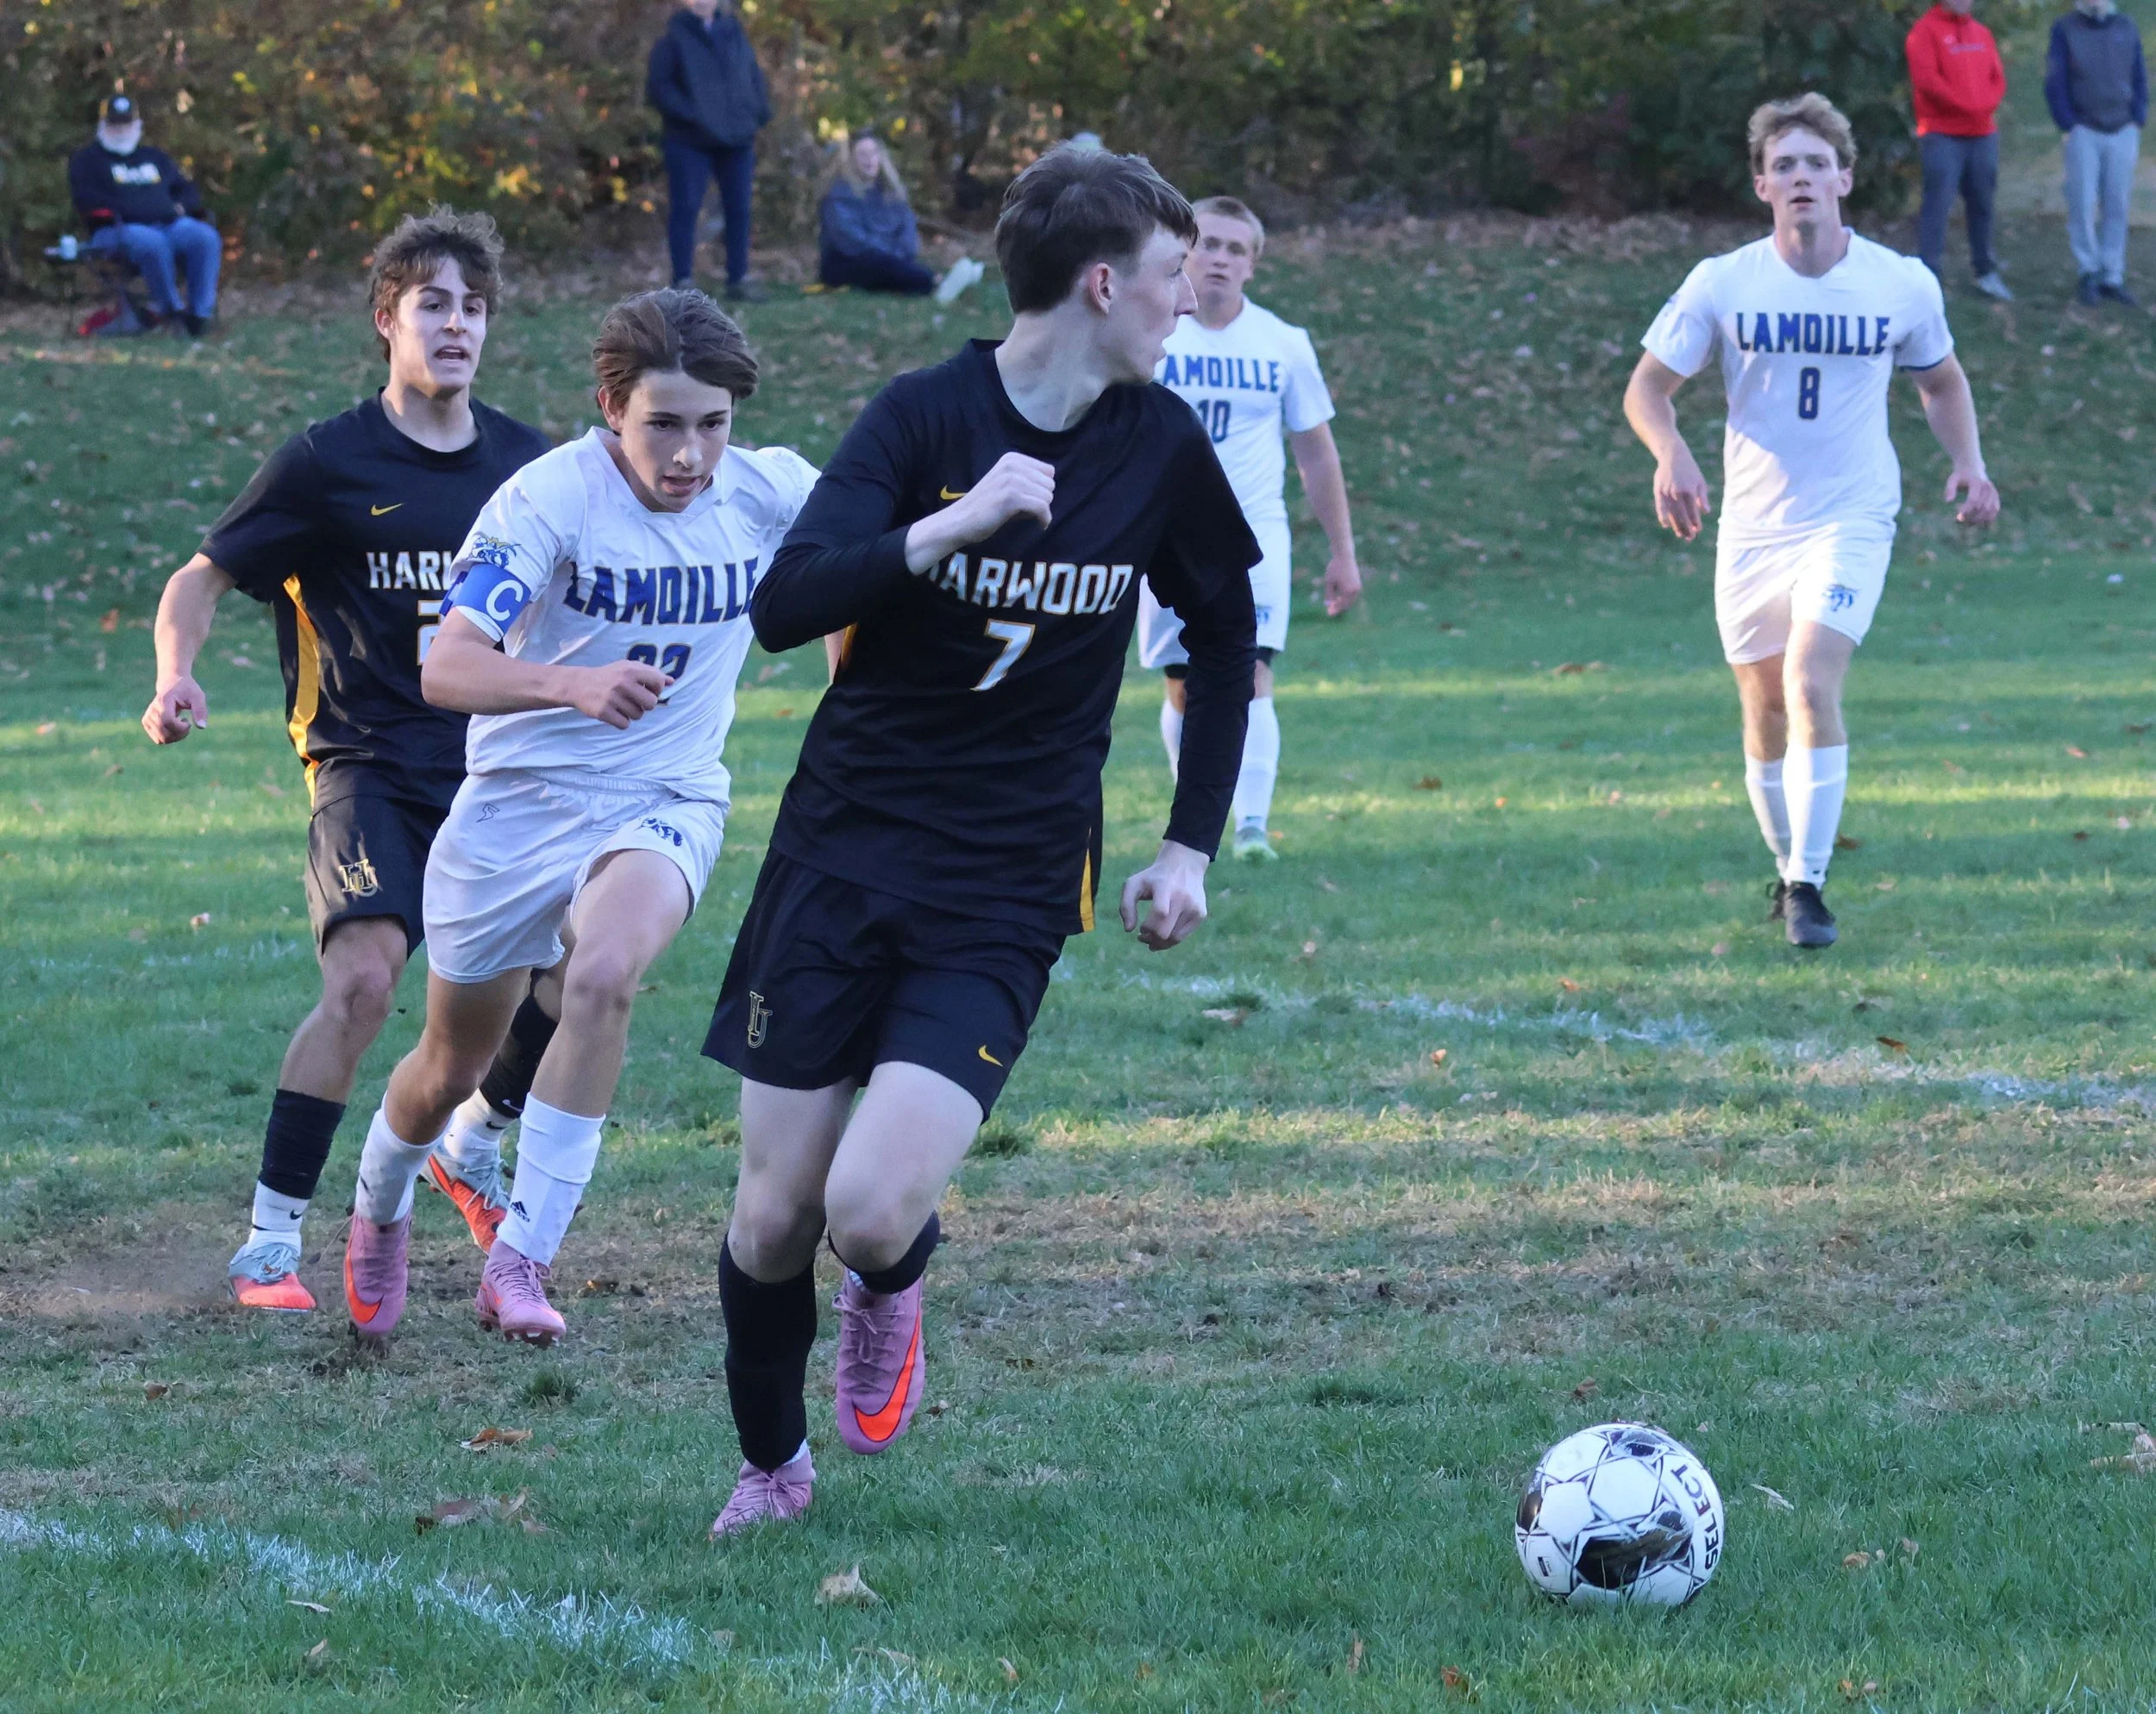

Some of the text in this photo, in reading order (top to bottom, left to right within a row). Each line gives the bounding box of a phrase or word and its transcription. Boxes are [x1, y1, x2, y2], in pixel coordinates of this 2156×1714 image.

[1736, 312, 1890, 356] LAMOILLE
[1163, 354, 1279, 393] AMOILLE
[1798, 366, 1821, 421] 8
[1197, 399, 1232, 443] 10
[486, 579, 524, 622] C
[562, 556, 759, 626] LAMOILLE
[930, 551, 1134, 615] ARWOOD
[969, 617, 1036, 691] 7
[1670, 1464, 1720, 1571] SELECT
